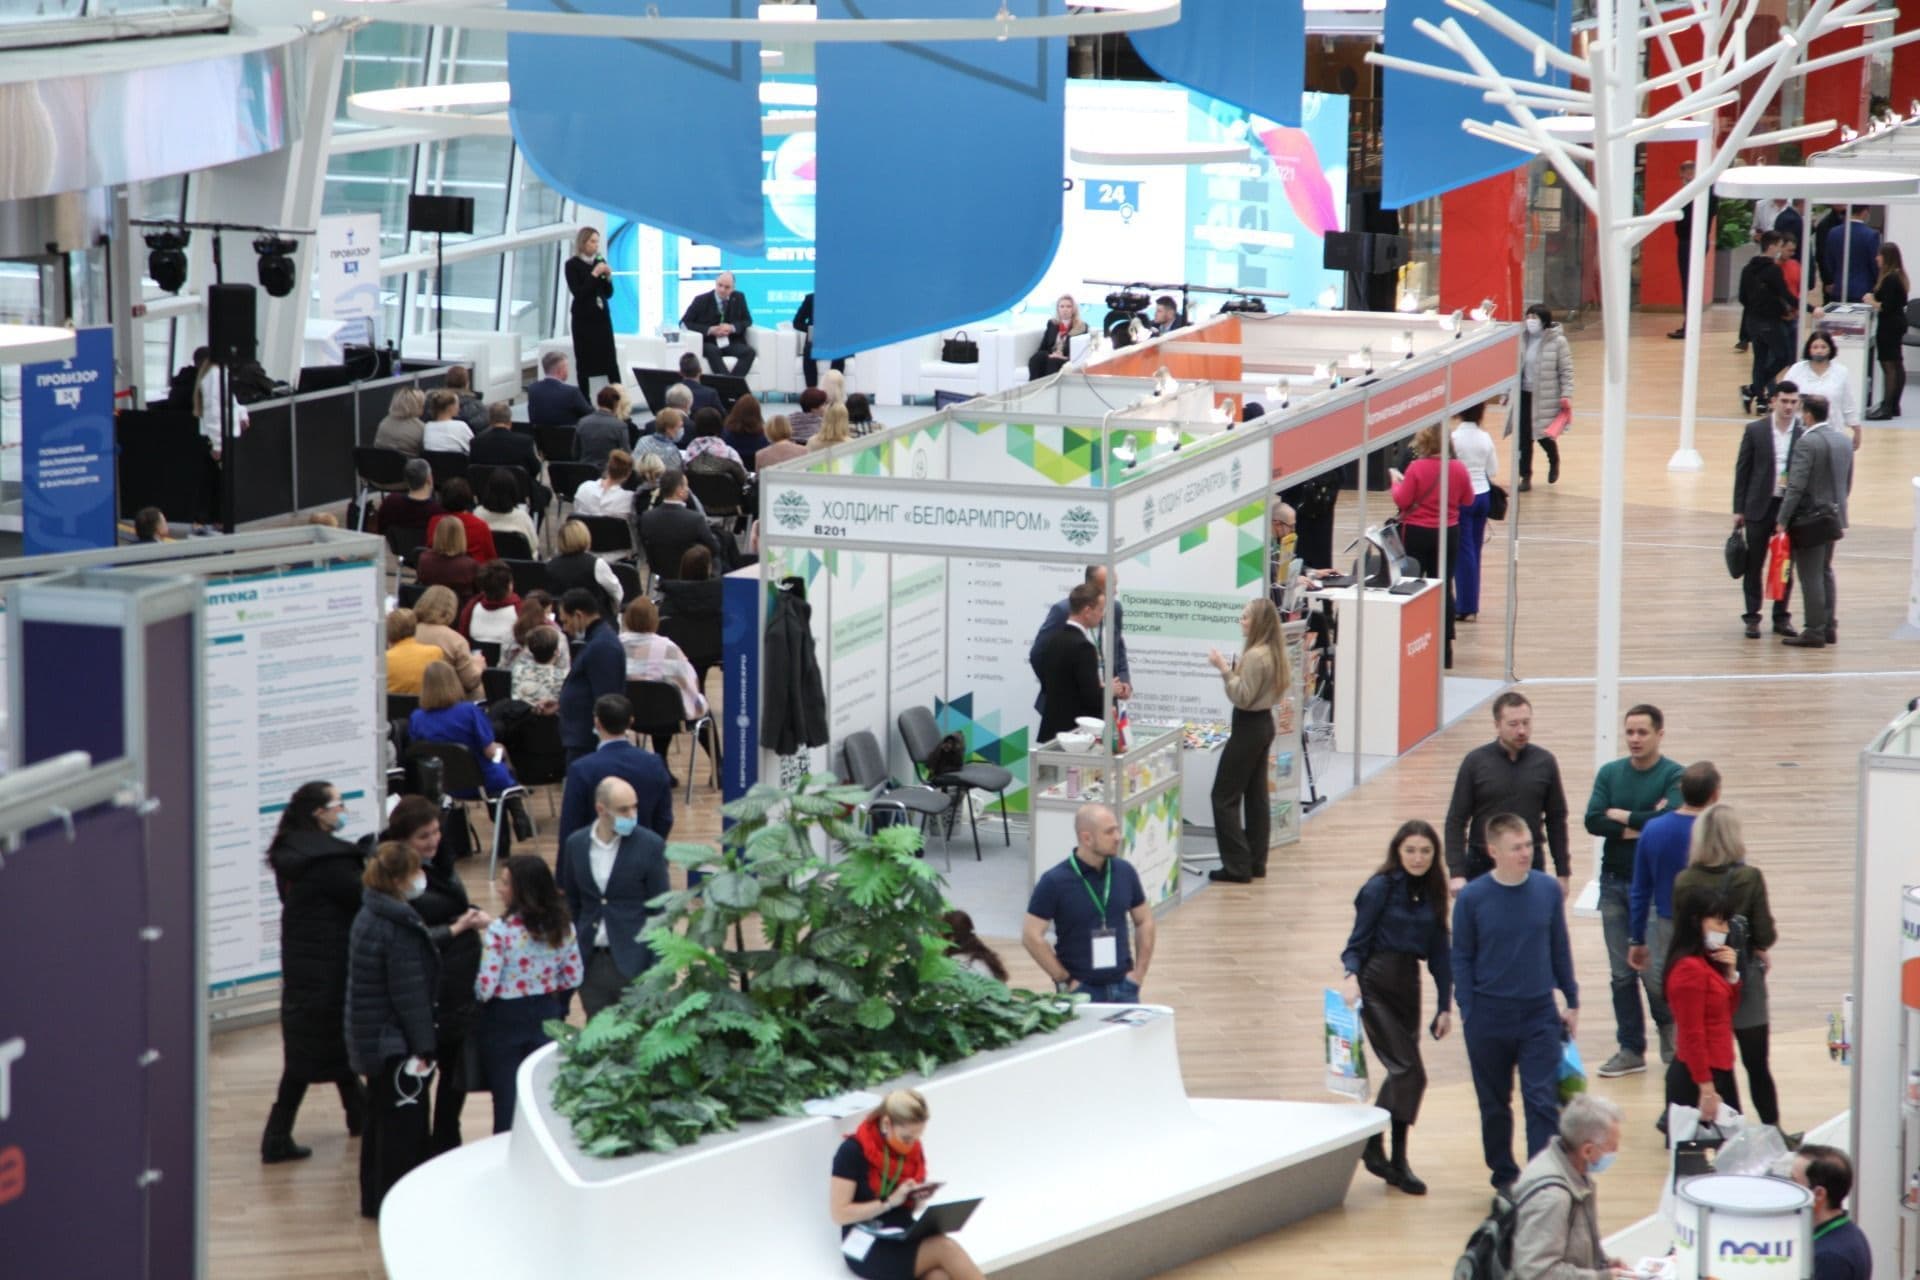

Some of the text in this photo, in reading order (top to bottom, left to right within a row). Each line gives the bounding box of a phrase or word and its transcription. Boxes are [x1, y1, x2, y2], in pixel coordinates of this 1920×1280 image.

[1098, 184, 1126, 204] 24
[330, 248, 371, 258] ПРОВИЗОР
[766, 247, 816, 261] апте
[36, 369, 98, 387] ПРОВИЗОР
[822, 500, 1050, 531] ХОЛДИНГ «БЕЛФАРМПРОМ»
[814, 525, 847, 537] B201
[1122, 593, 1192, 607] Производство
[1191, 613, 1240, 624] стандарта
[1121, 622, 1161, 632] отрасли
